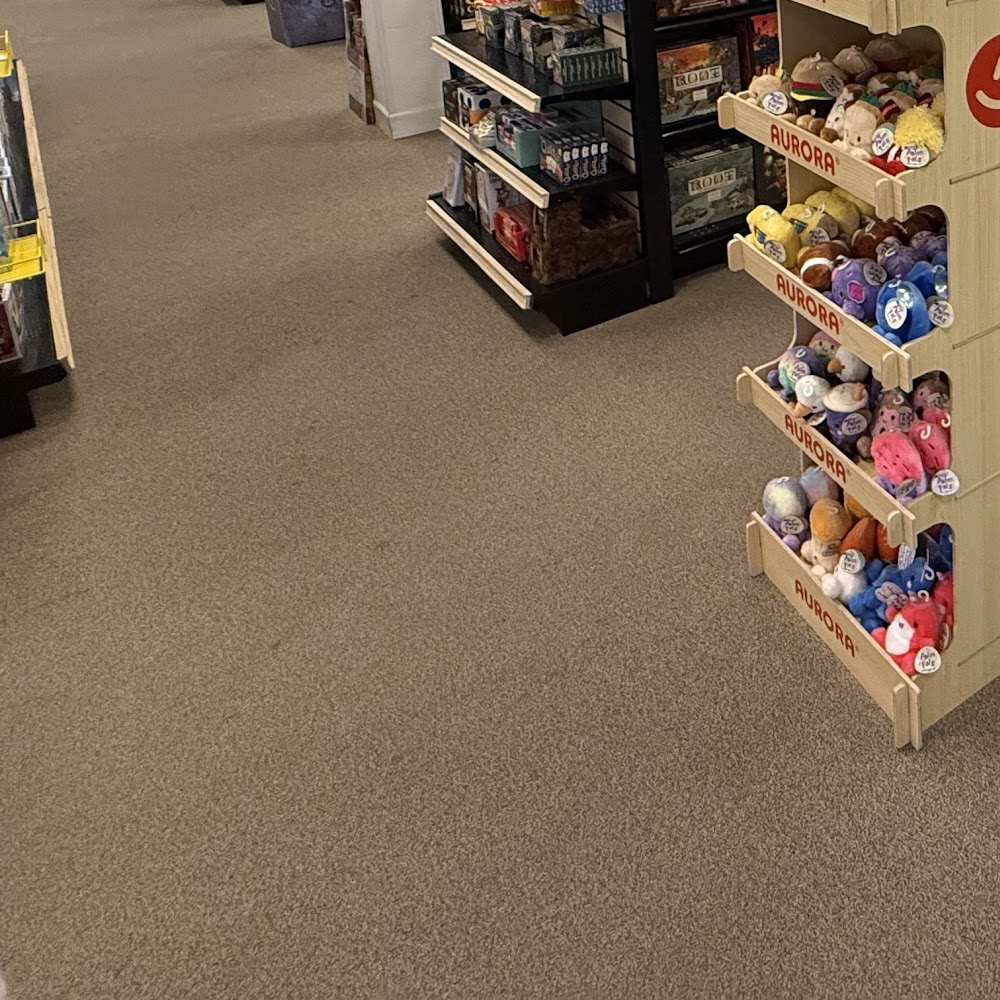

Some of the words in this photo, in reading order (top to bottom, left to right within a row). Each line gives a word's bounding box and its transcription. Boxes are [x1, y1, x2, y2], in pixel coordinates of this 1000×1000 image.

[770, 124, 835, 176] AURORA
[776, 273, 840, 335] AURORA
[785, 413, 846, 484] AURORA
[794, 579, 856, 659] AURORA
